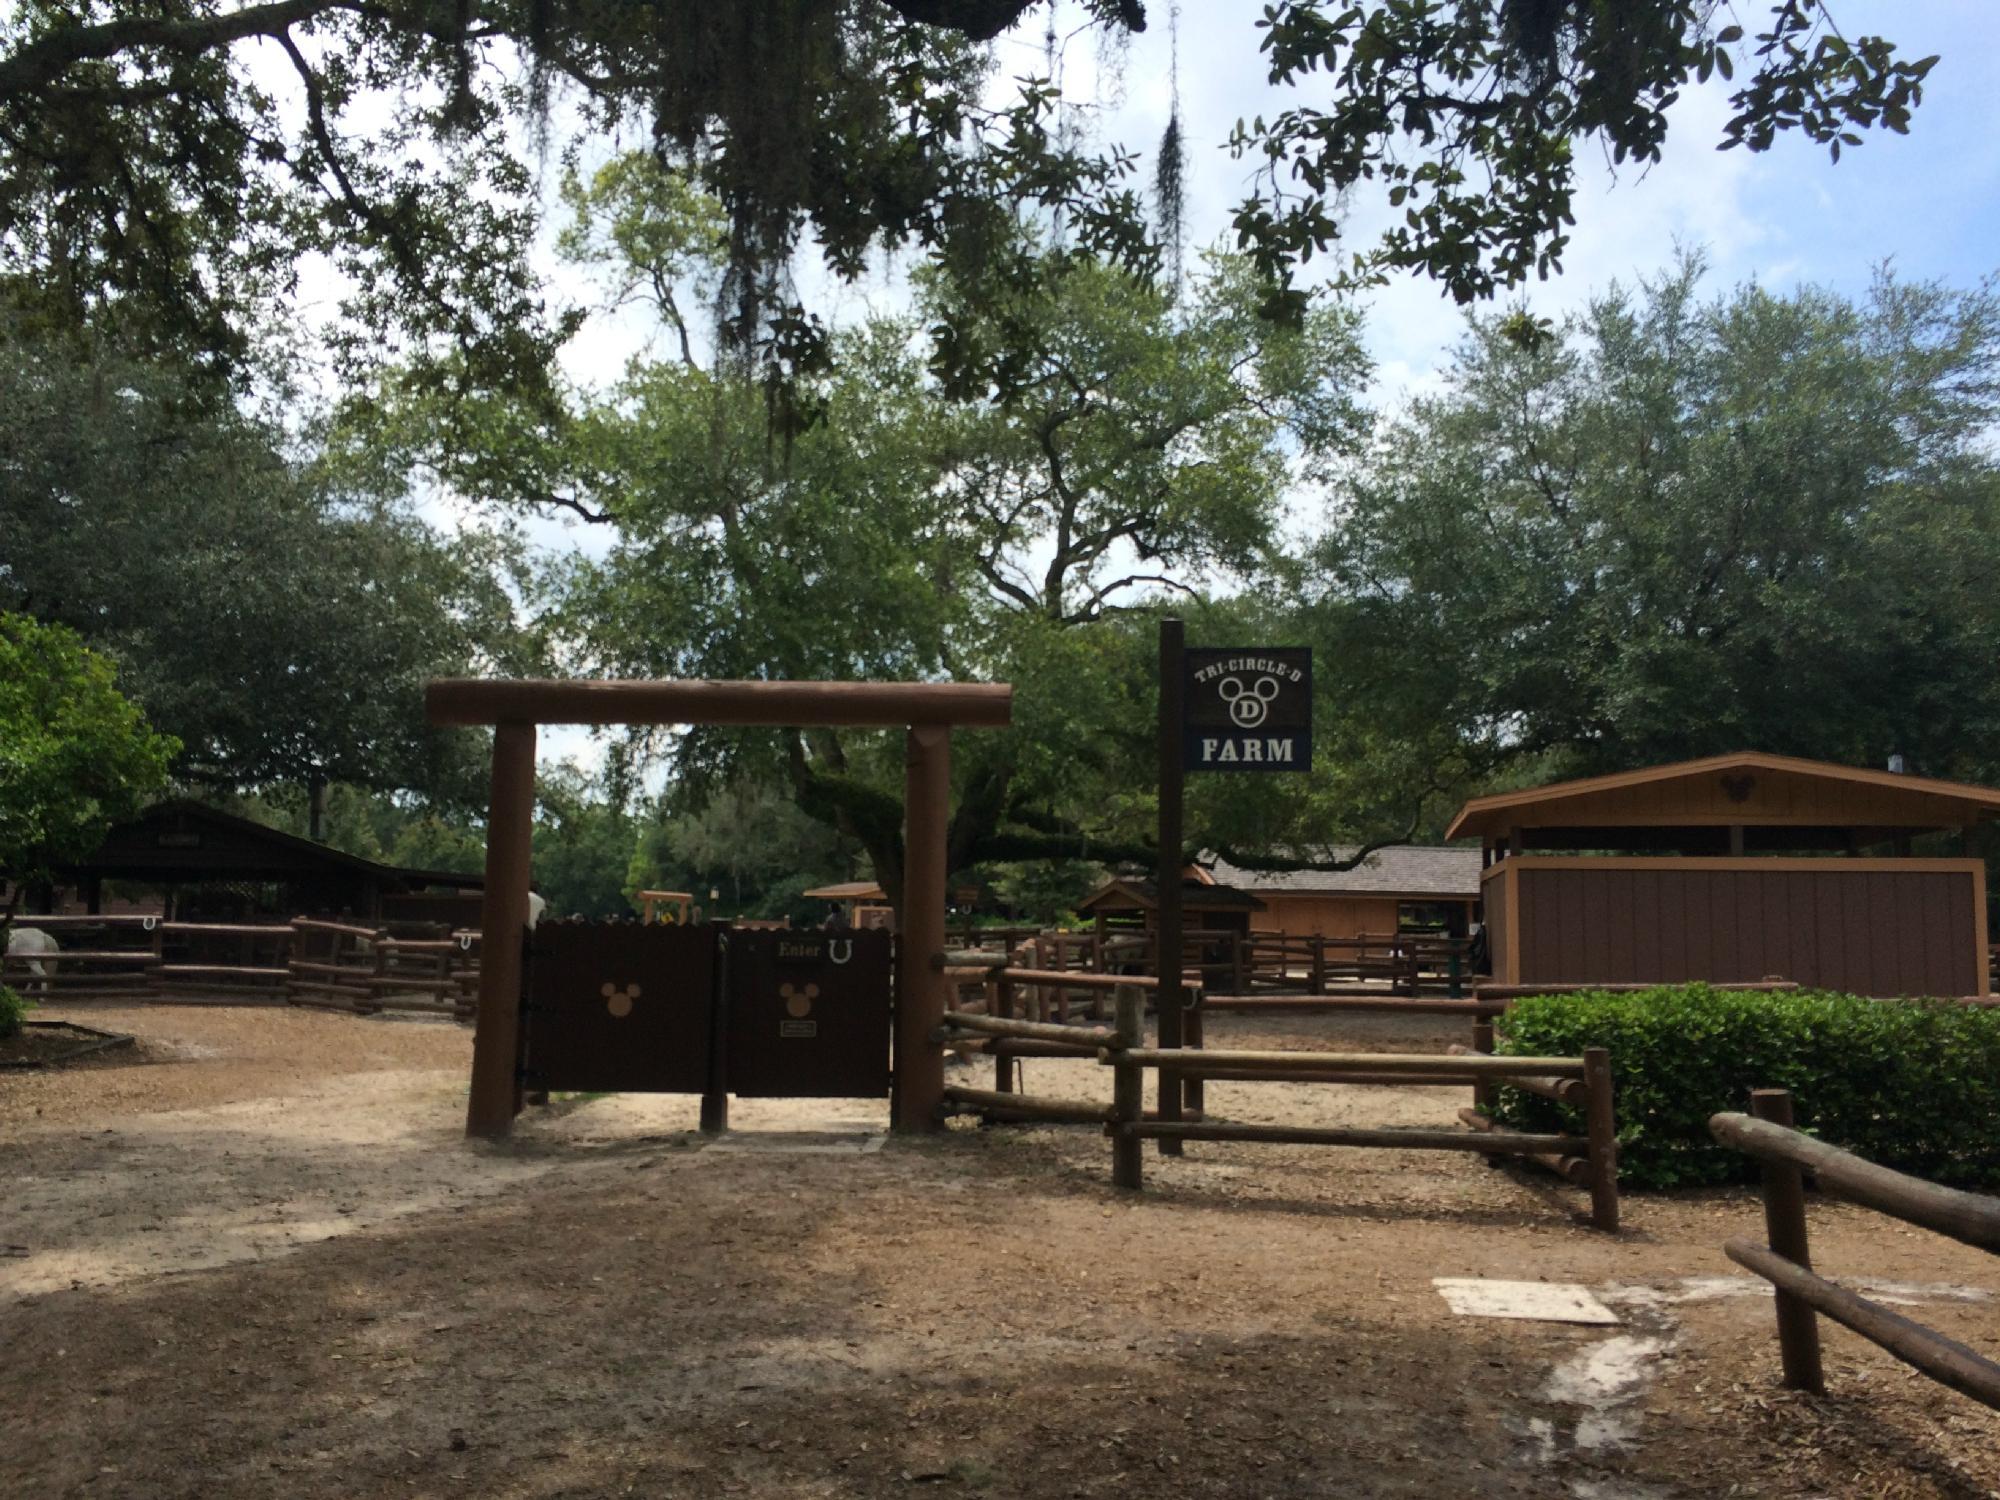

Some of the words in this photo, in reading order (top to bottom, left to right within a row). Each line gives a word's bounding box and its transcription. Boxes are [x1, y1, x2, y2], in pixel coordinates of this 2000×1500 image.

[1194, 657, 1304, 683] TRI-CIRCLE-D
[1238, 700, 1261, 719] D
[1201, 738, 1294, 762] FARM
[778, 942, 821, 957] Enter
